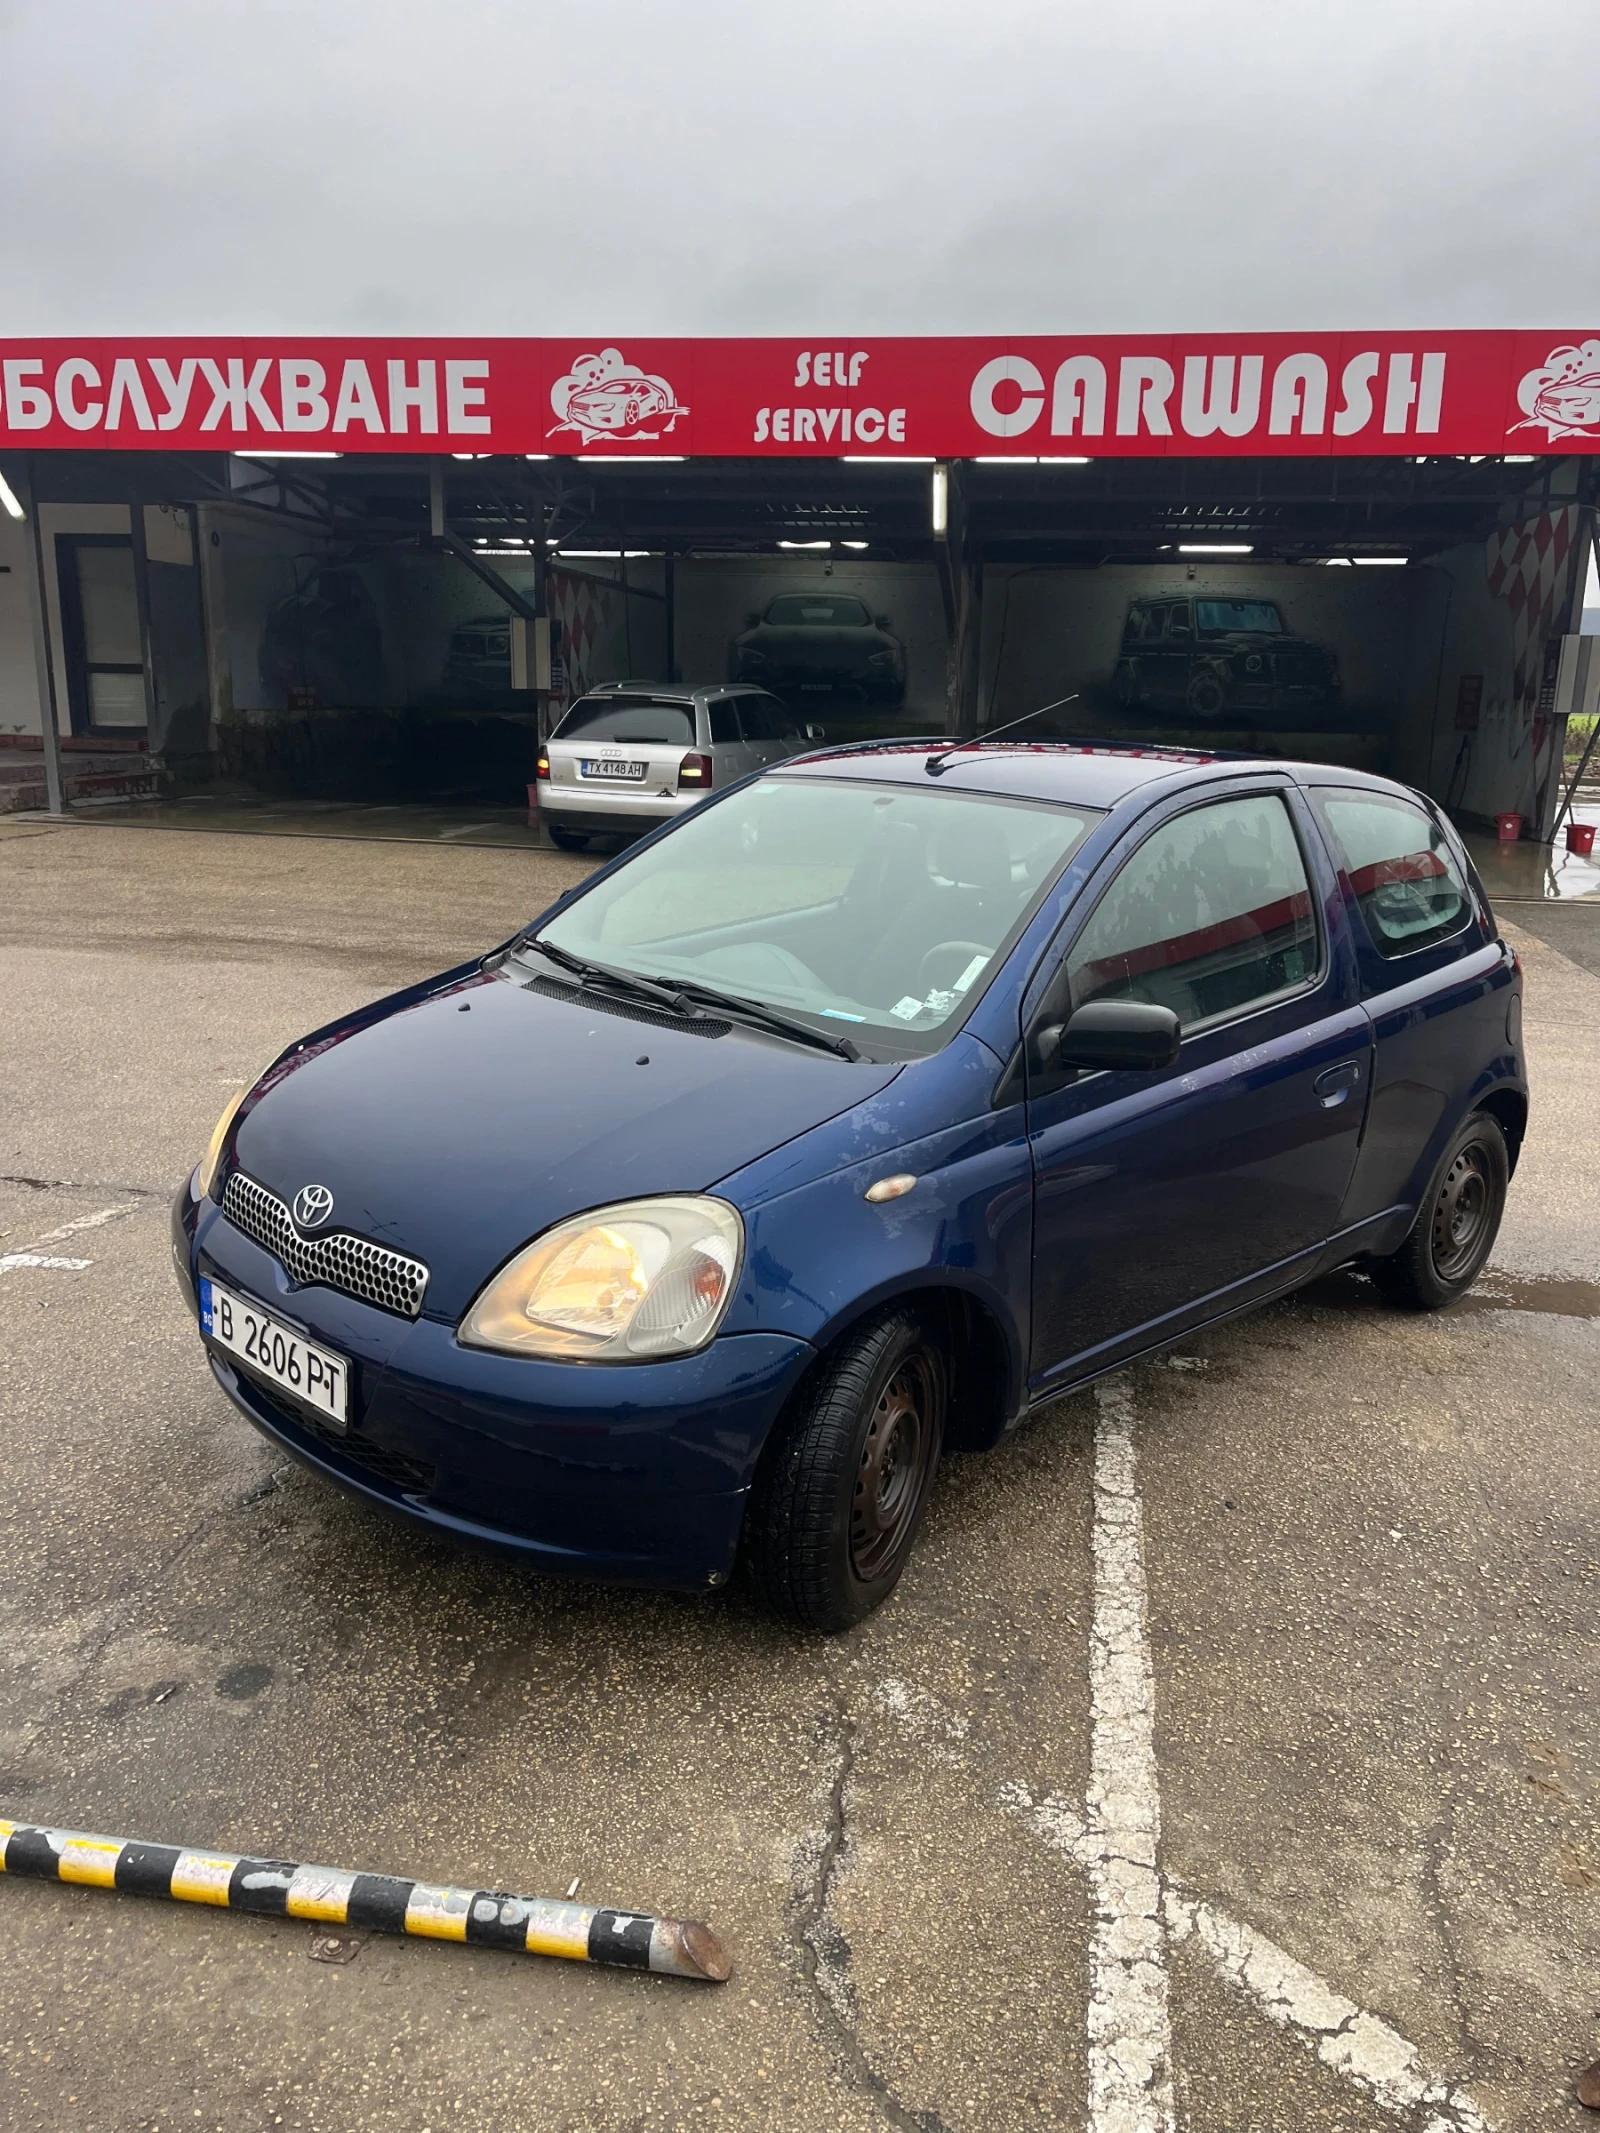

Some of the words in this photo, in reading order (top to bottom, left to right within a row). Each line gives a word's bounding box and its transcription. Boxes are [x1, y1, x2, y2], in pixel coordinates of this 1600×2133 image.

[794, 351, 870, 388] SELF
[0, 357, 492, 435] БСЛУЖВАНЕ
[969, 351, 1447, 438] CARWASH
[753, 407, 906, 443] SERVICE
[589, 763, 601, 774] TX
[603, 763, 626, 775] 4148
[628, 764, 641, 775] AH
[203, 1311, 213, 1327] BG
[220, 1296, 233, 1342] B
[244, 1314, 301, 1386] 2606
[307, 1350, 340, 1409] PT
